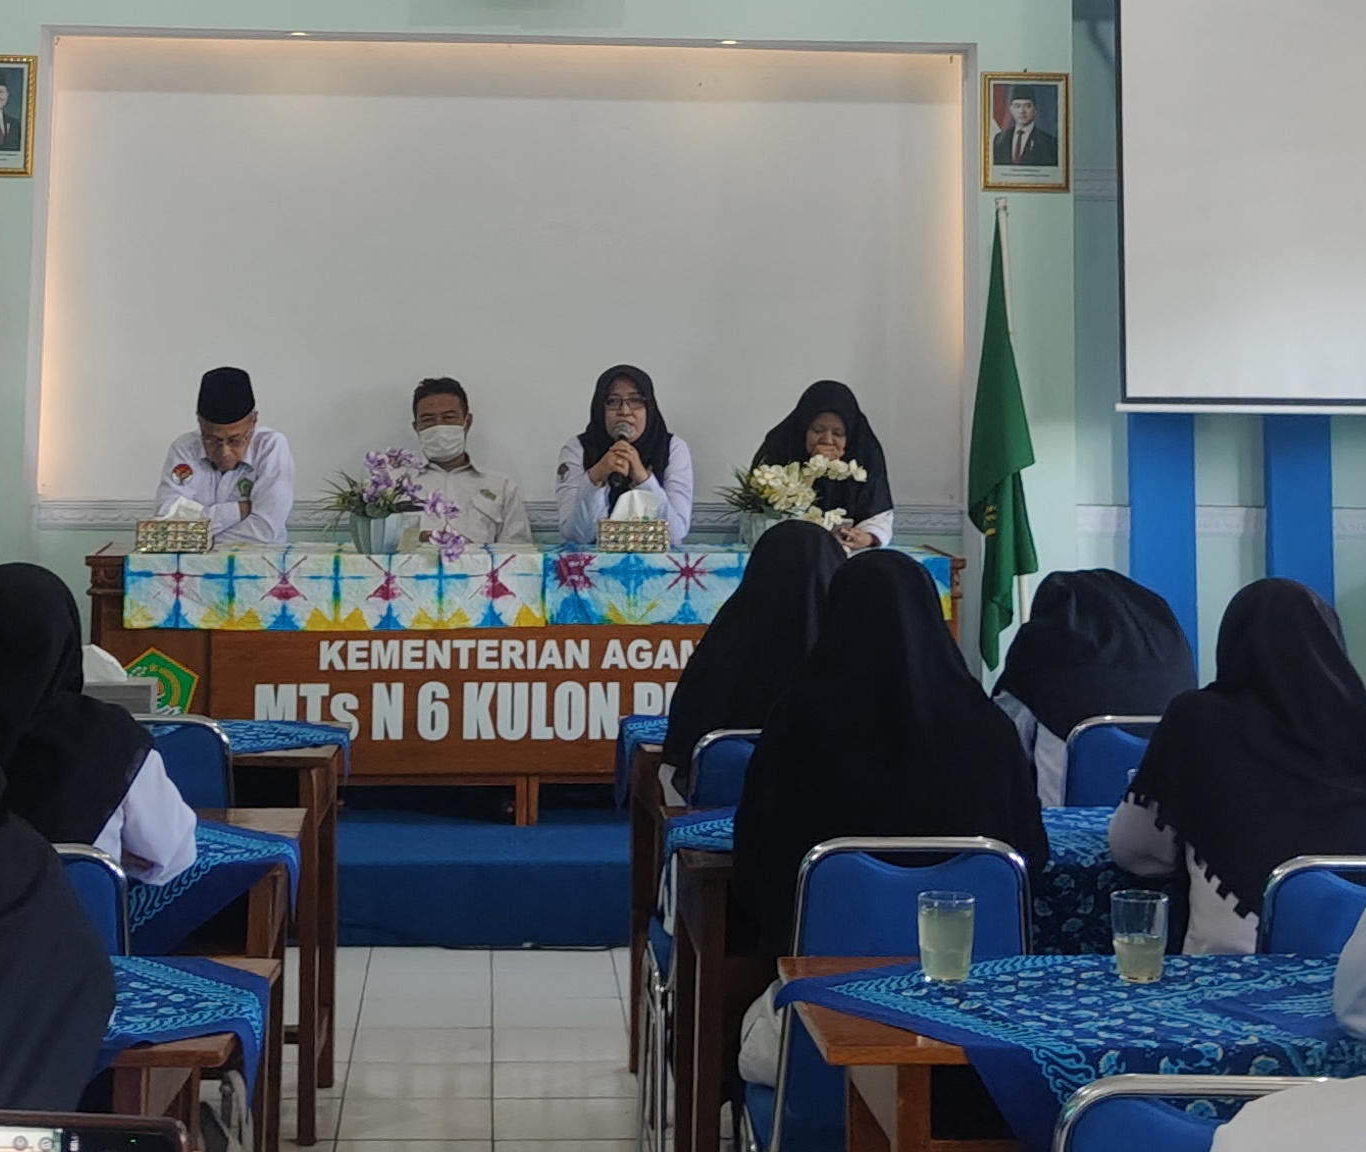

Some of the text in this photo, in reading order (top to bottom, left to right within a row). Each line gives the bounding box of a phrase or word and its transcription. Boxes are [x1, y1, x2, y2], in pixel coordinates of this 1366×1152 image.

[319, 639, 590, 671] KEMENTERIAN
[255, 683, 360, 741] MTs
[372, 682, 404, 740] N
[418, 682, 450, 741] 6
[463, 681, 620, 741] KULON
